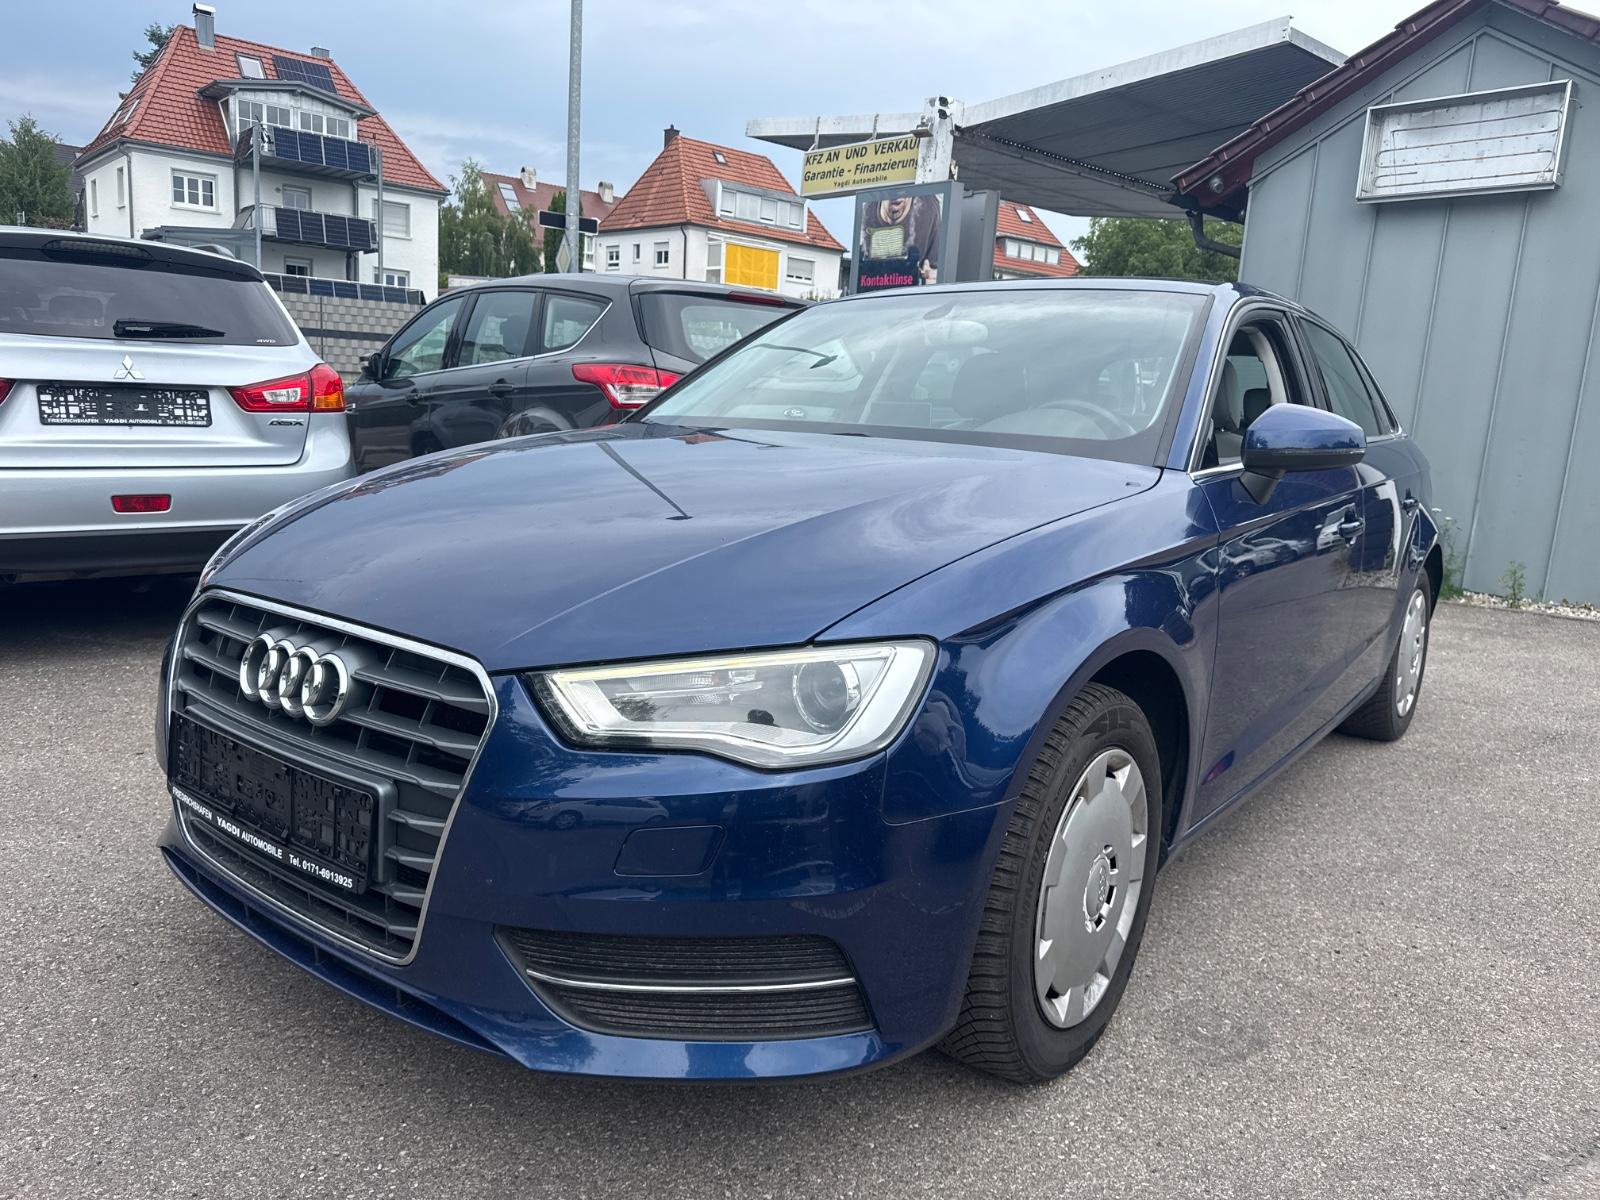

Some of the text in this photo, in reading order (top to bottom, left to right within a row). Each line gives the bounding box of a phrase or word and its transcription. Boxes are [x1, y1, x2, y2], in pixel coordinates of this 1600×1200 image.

[805, 154, 823, 166] KFZ
[825, 150, 840, 163] AN
[845, 146, 868, 160] UND
[804, 166, 845, 182] Garantie
[833, 180, 850, 188] Yagdi
[860, 272, 913, 287] Kontaktlinse
[268, 418, 304, 426] ASX
[172, 786, 353, 888] FRIEDRICHSHAFEN YAGDI AUTOMOBILE Tel. 0171-6913925
